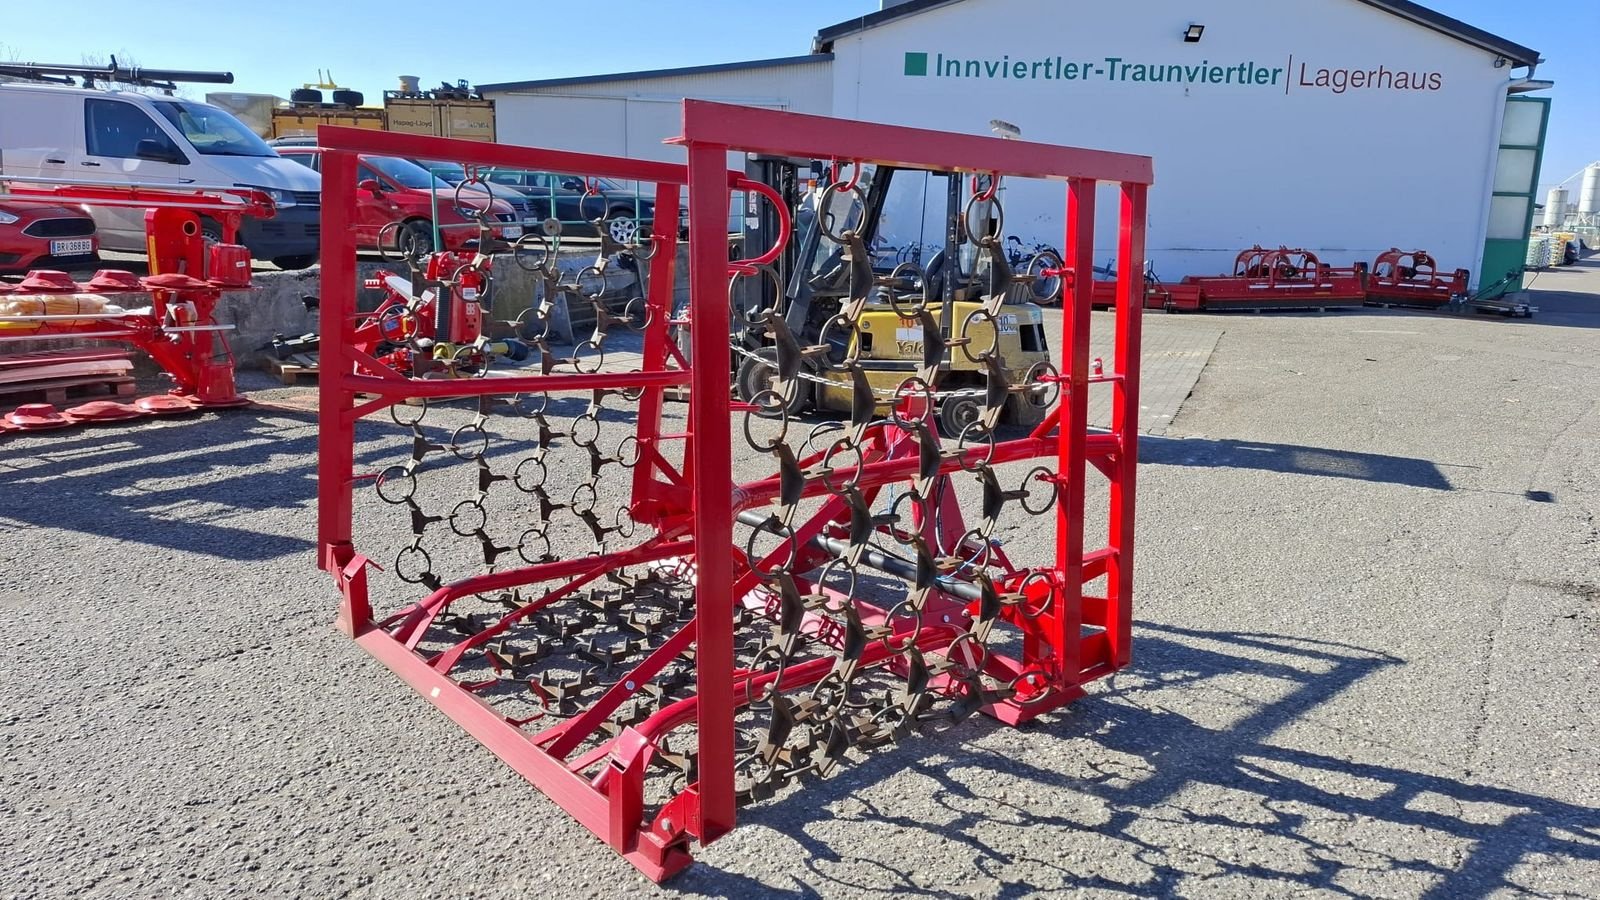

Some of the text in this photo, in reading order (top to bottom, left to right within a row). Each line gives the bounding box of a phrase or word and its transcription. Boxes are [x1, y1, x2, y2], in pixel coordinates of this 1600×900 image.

[936, 53, 1443, 94] Innviertler-Traunviertler Lagerhaus
[393, 119, 433, 128] Hapag-Lloyd
